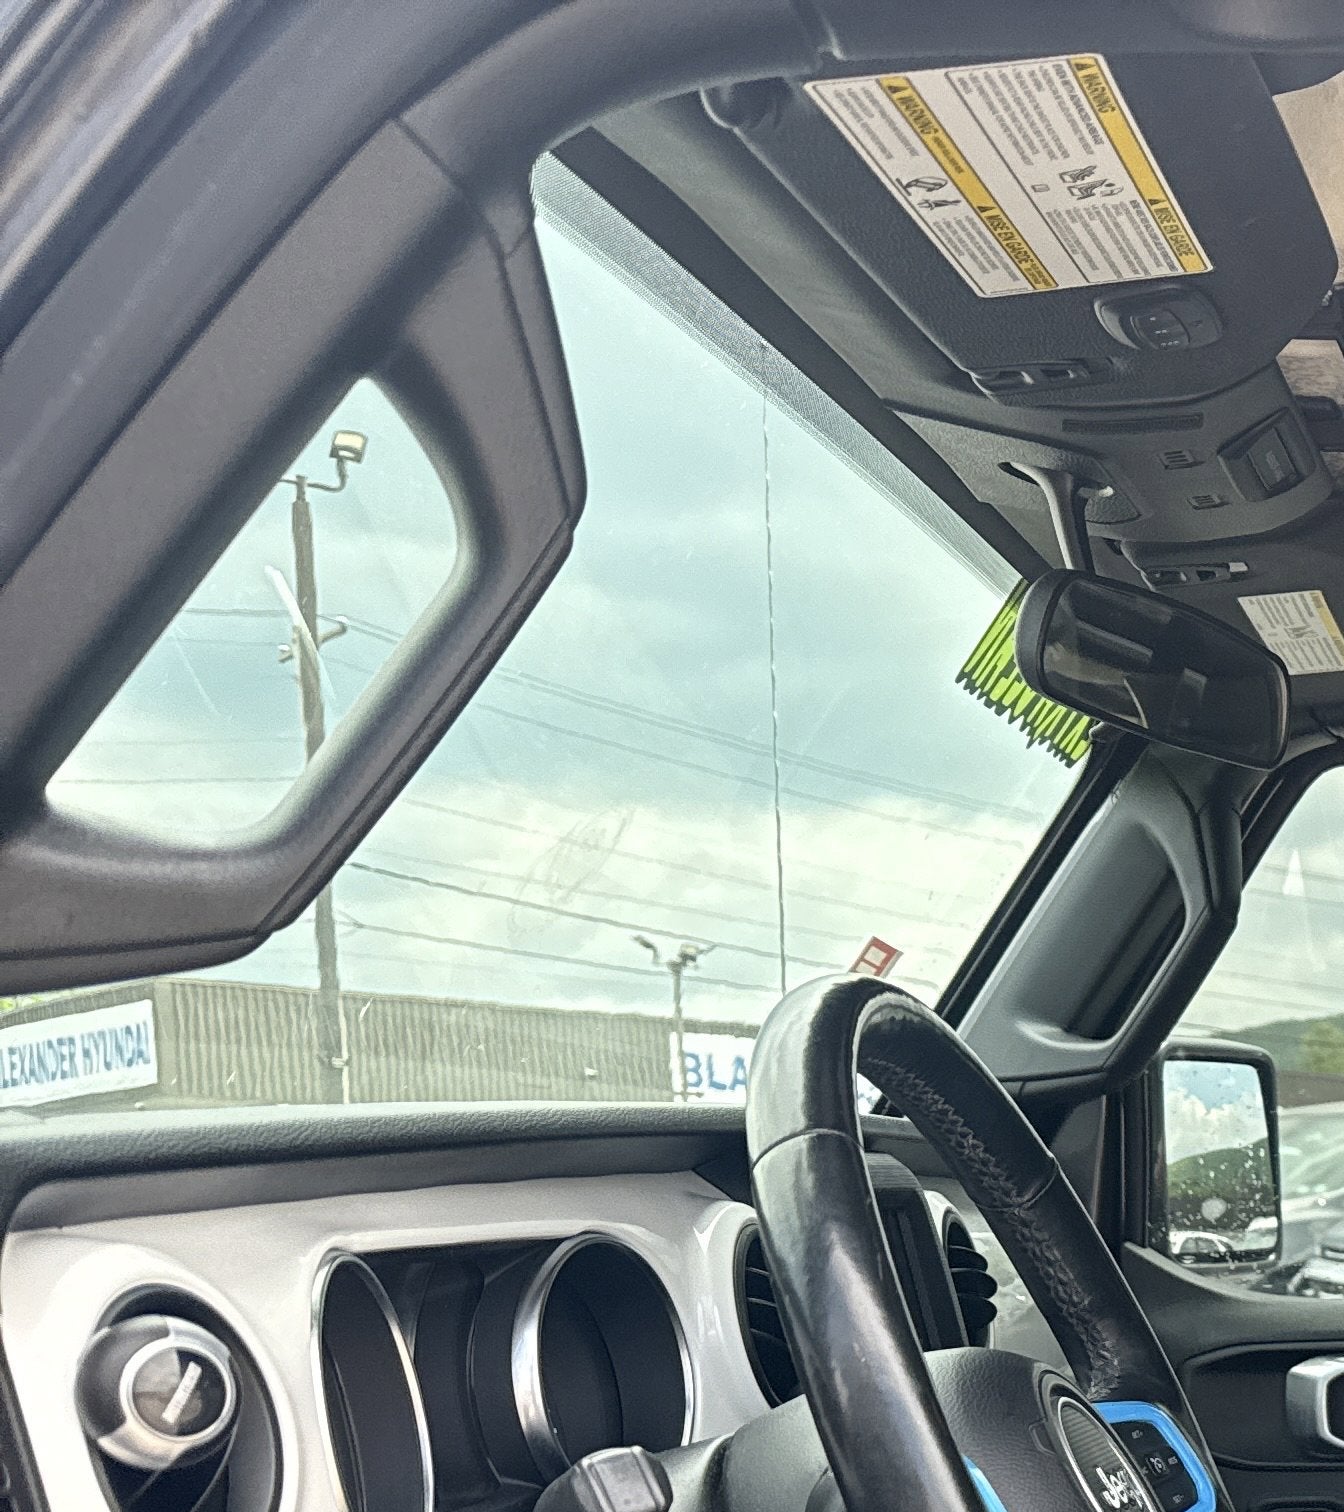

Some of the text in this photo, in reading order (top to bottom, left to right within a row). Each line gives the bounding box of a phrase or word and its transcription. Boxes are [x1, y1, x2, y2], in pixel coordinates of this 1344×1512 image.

[1080, 73, 1116, 113] WARNING
[897, 96, 938, 135] WARNING
[984, 214, 1009, 231] MISE
[996, 231, 1018, 241] EN
[1153, 207, 1193, 256] MISE EN GARDE
[1005, 241, 1033, 264] GARDE
[0, 1020, 151, 1089] LEXANDER HYUNDAI
[681, 1052, 747, 1091] BLA
